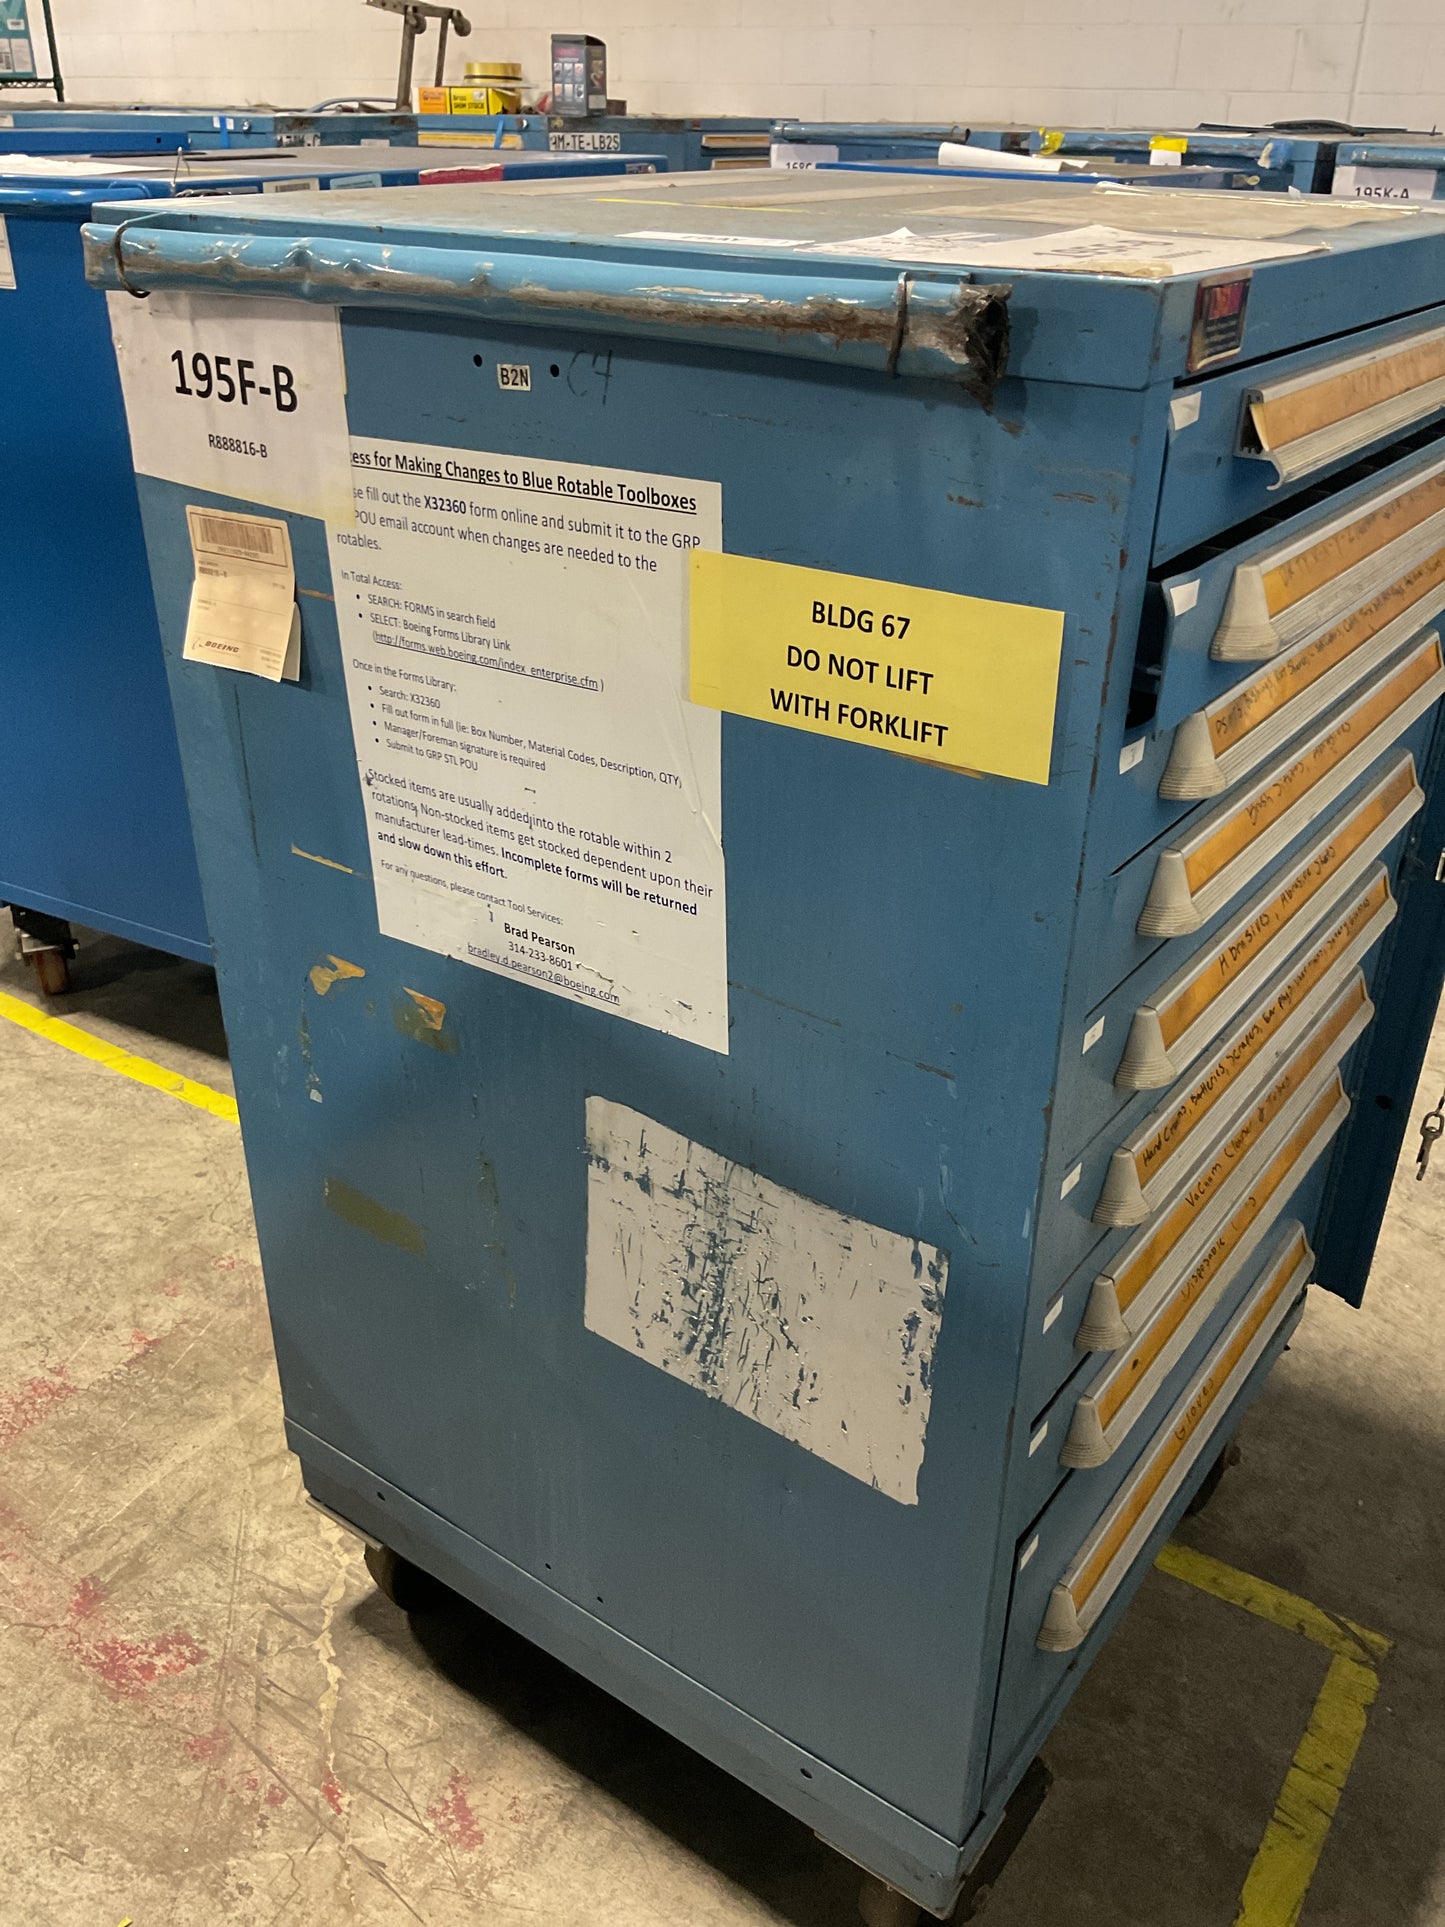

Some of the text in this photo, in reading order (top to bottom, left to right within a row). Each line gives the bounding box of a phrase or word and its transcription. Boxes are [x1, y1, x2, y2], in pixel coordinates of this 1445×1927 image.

[170, 348, 298, 414] 195F-B
[500, 367, 530, 387] B2N
[207, 433, 269, 459] R888816-B
[373, 450, 392, 468] for
[395, 454, 443, 478] Making
[445, 461, 501, 484] Changes
[503, 469, 519, 485] to
[522, 470, 553, 490] Blue
[557, 475, 614, 499] Rotable
[616, 483, 697, 511] Toolboxes
[336, 531, 382, 551] rotables.
[365, 486, 380, 502] fill
[381, 490, 400, 505] out
[402, 492, 422, 509] the
[423, 495, 467, 515] X32360
[469, 501, 498, 520] form
[501, 507, 539, 526] online
[541, 514, 565, 530] and
[567, 517, 612, 538] submit
[615, 523, 625, 540] it
[627, 526, 642, 542] to
[645, 528, 668, 547] the
[671, 532, 701, 550] GRP
[379, 516, 409, 531] email
[411, 520, 456, 539] account
[457, 526, 490, 545] when
[492, 531, 541, 554] changes
[543, 542, 564, 557] are
[567, 545, 614, 565] needed
[617, 552, 632, 568] to
[635, 554, 658, 572] the
[341, 569, 403, 591] In Total Access:
[367, 593, 497, 629] SEARCH: FORMS in search field
[369, 612, 512, 652] SELECT: Boeing Forms Library Link
[811, 599, 911, 641] BLDG 67
[204, 639, 241, 654] BOEING
[786, 644, 935, 696] DO NOT LIFT
[352, 658, 457, 693] Once in the Forms Library:
[378, 685, 441, 709] Search: X32360
[769, 687, 950, 748] WITH FORKLIFT
[381, 703, 682, 789] Fill out form in full (ie: Box Number, Material Codes, Description, QTY)
[383, 720, 546, 772] Manager/Foreman signature is required
[385, 738, 479, 772] Submit to GRP STL POU
[367, 768, 673, 864] Stocked items are usually added into the rotable within 2
[374, 811, 698, 916] manufacturer lead-times. Incomplete forms will be returned
[377, 830, 509, 880] and slow down this effort.
[420, 802, 484, 832] Non-stocked
[485, 821, 516, 841] items
[517, 832, 536, 848] get
[537, 839, 581, 860] stocked
[583, 850, 647, 880] dependent
[649, 870, 681, 889] upon
[683, 879, 714, 898] their
[380, 859, 564, 926] For any questions, please contact Tool Services:
[503, 922, 576, 956] Brad Pearson
[508, 941, 573, 972] 314-233-8601
[466, 941, 621, 1006] bradley.d.pearson2@boeing.com
[1142, 1132, 1163, 1168] Hand
[1174, 1377, 1214, 1441] Gloves
